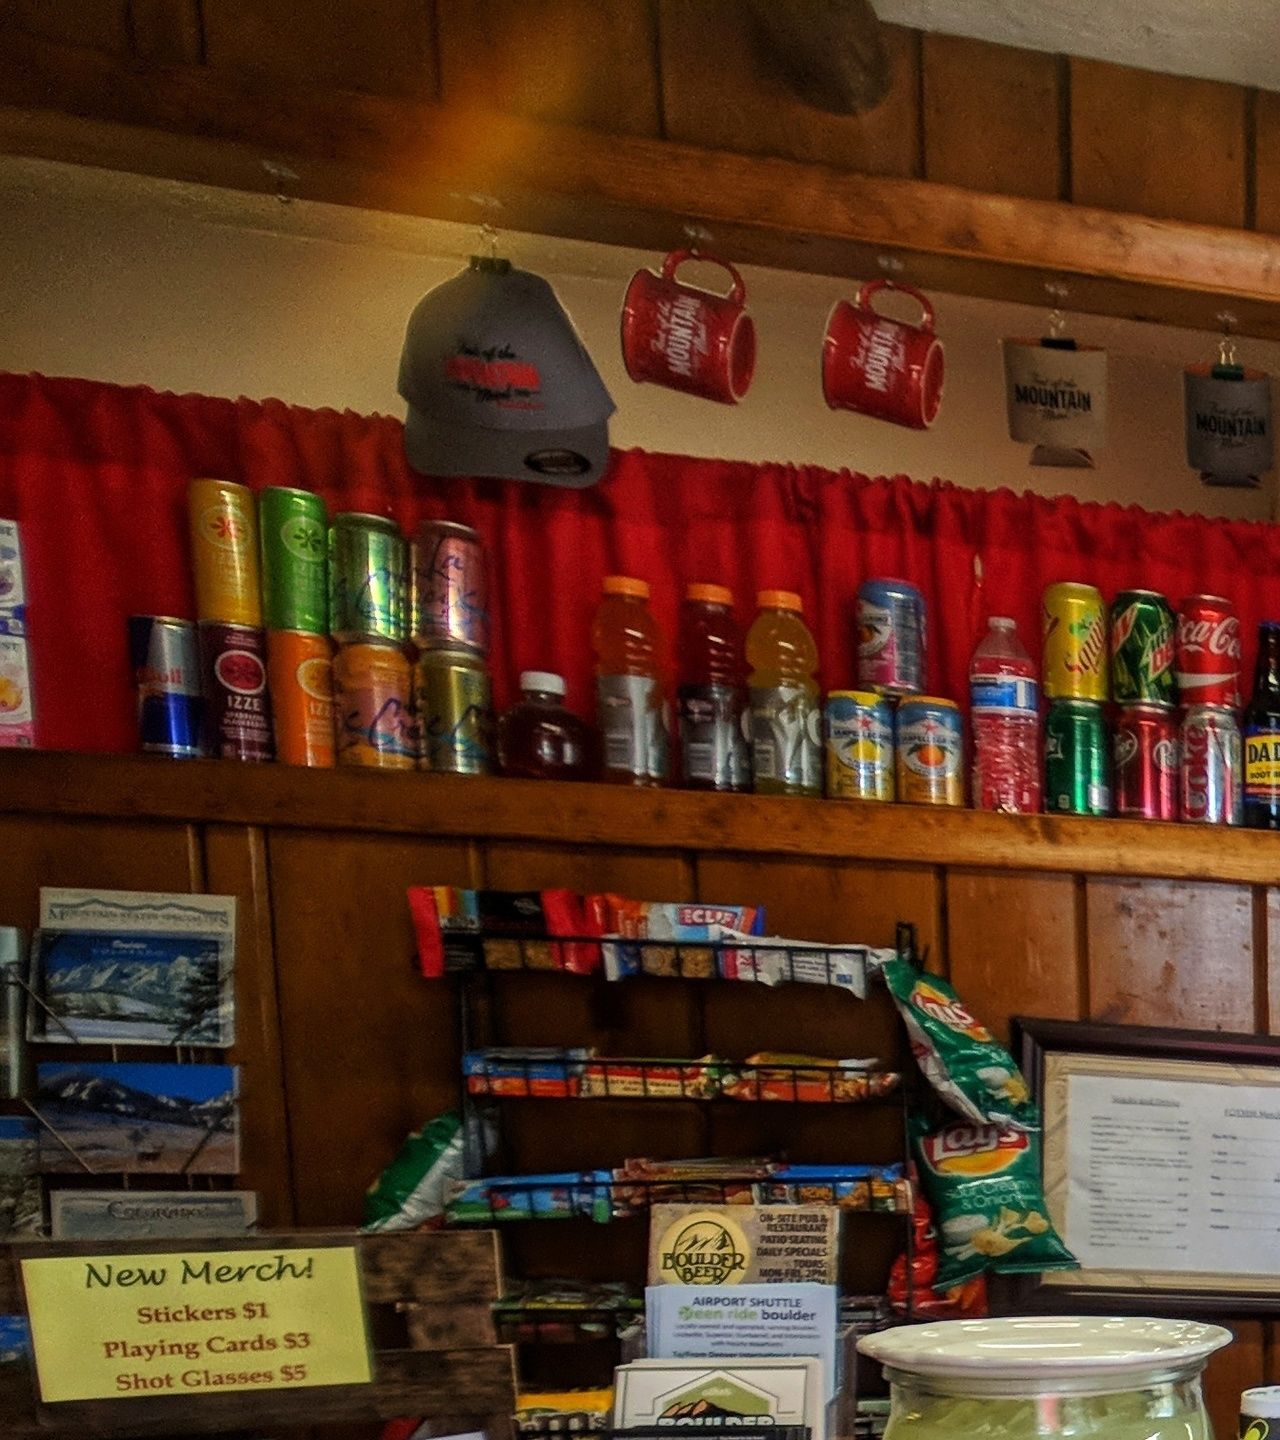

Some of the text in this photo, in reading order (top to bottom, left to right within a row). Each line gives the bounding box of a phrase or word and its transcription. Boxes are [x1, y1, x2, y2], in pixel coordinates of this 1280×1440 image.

[666, 295, 702, 378] MOUNTAIN
[1013, 383, 1093, 412] MOUNTAIN
[1195, 412, 1267, 437] MOUNTAIN
[226, 695, 262, 712] IZZE
[766, 1223, 828, 1233] RESTAURANT
[760, 1235, 828, 1245] PATIO SEATING
[662, 1252, 746, 1271] BOULDER
[784, 1249, 828, 1258] SPECIALS
[85, 1255, 313, 1289] New Merch!
[682, 1267, 725, 1283] BEER
[692, 1296, 802, 1308] AIRPORT SHUTTLE
[137, 1301, 269, 1325] Stickers $1
[727, 1308, 758, 1320] ride
[761, 1309, 817, 1321] boulder
[103, 1332, 311, 1363] Playing Cards $3
[115, 1364, 307, 1392] Shot Glasses $5
